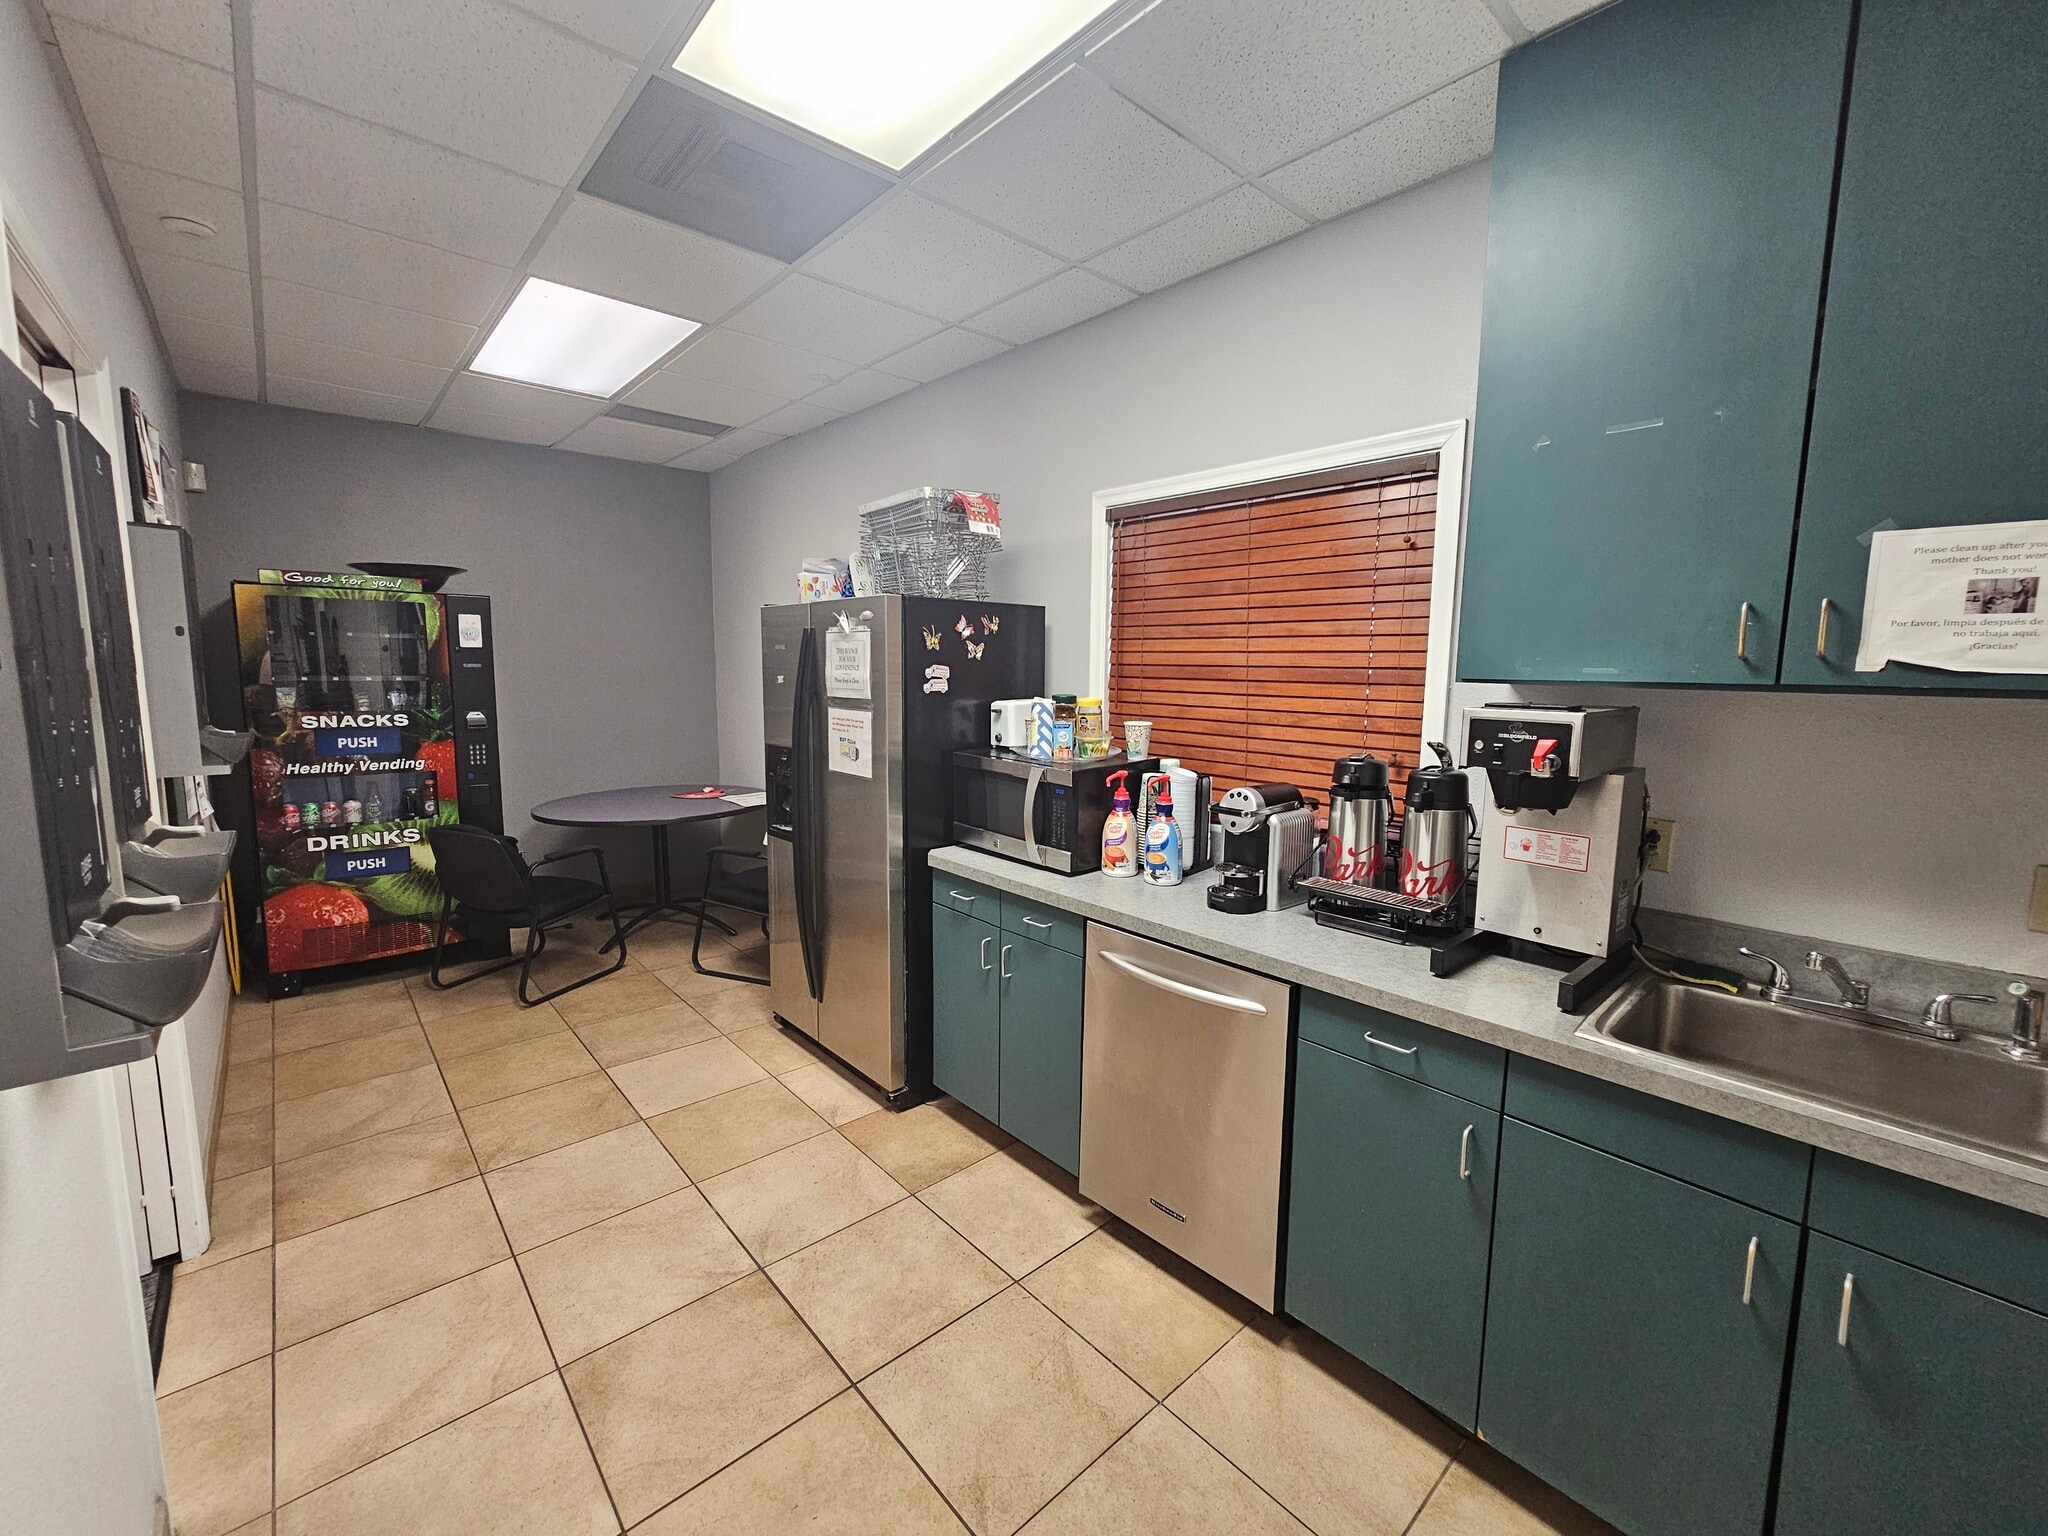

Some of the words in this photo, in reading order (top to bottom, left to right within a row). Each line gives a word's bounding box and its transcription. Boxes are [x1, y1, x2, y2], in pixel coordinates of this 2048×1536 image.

[1914, 547, 1948, 555] Please
[1950, 544, 1979, 553] clean
[1981, 544, 1996, 553] up
[1999, 541, 2026, 550] after
[1931, 555, 1970, 564] mother
[1973, 554, 1999, 563] does
[2002, 553, 2021, 561] not
[1973, 566, 2009, 576] Thank
[283, 572, 335, 584] Good
[340, 575, 366, 585] for
[370, 578, 402, 589] you!
[1890, 620, 1909, 628] Por
[1943, 618, 1978, 628] limpia
[1979, 617, 2027, 628] después
[1969, 629, 2010, 638] trabaja
[301, 713, 410, 729] SNACKS
[337, 736, 378, 749] PUSH
[285, 762, 355, 776] Healthy
[359, 758, 426, 771] Vending
[307, 828, 421, 852] DRINKS
[347, 857, 387, 871] PUSH
